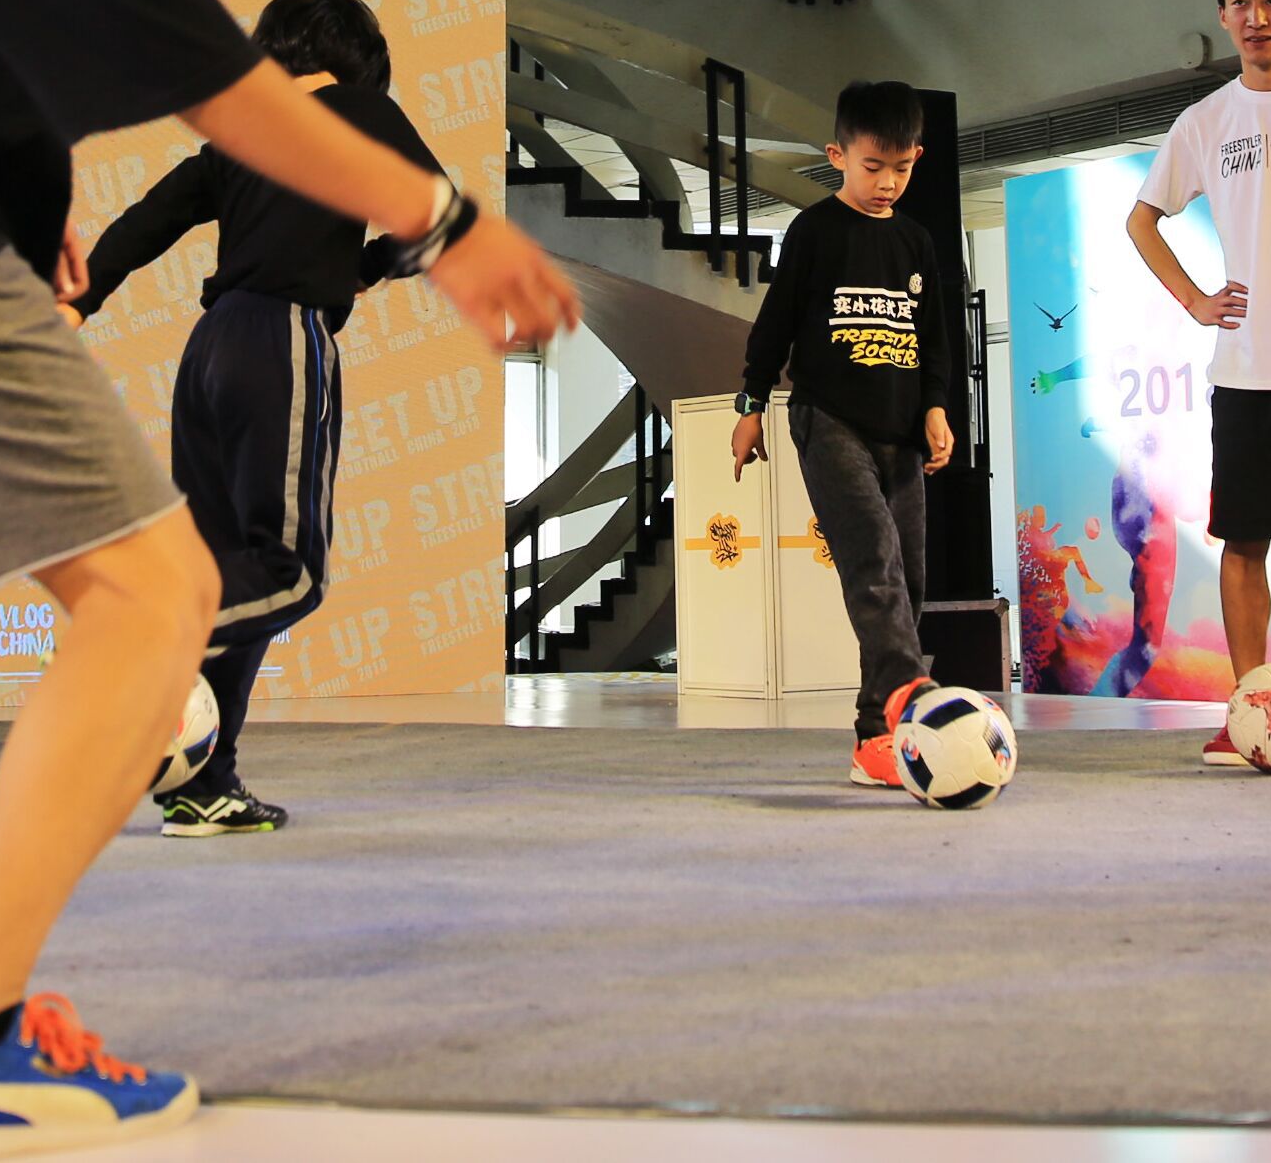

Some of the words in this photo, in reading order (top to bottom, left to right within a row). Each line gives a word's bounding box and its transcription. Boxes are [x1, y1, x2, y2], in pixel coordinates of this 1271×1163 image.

[411, 7, 473, 38] FREESTYLE
[432, 103, 491, 136] FREESTYLE
[1221, 133, 1262, 157] FREESTYLER
[79, 155, 147, 215] UP
[153, 240, 217, 303] UP
[386, 327, 427, 353] CHINA
[425, 365, 483, 426] UP
[1120, 362, 1213, 418] 201
[406, 428, 447, 455] CHINA
[332, 498, 391, 562] UP
[420, 515, 486, 551] FREESTYLE
[329, 606, 391, 669] UP
